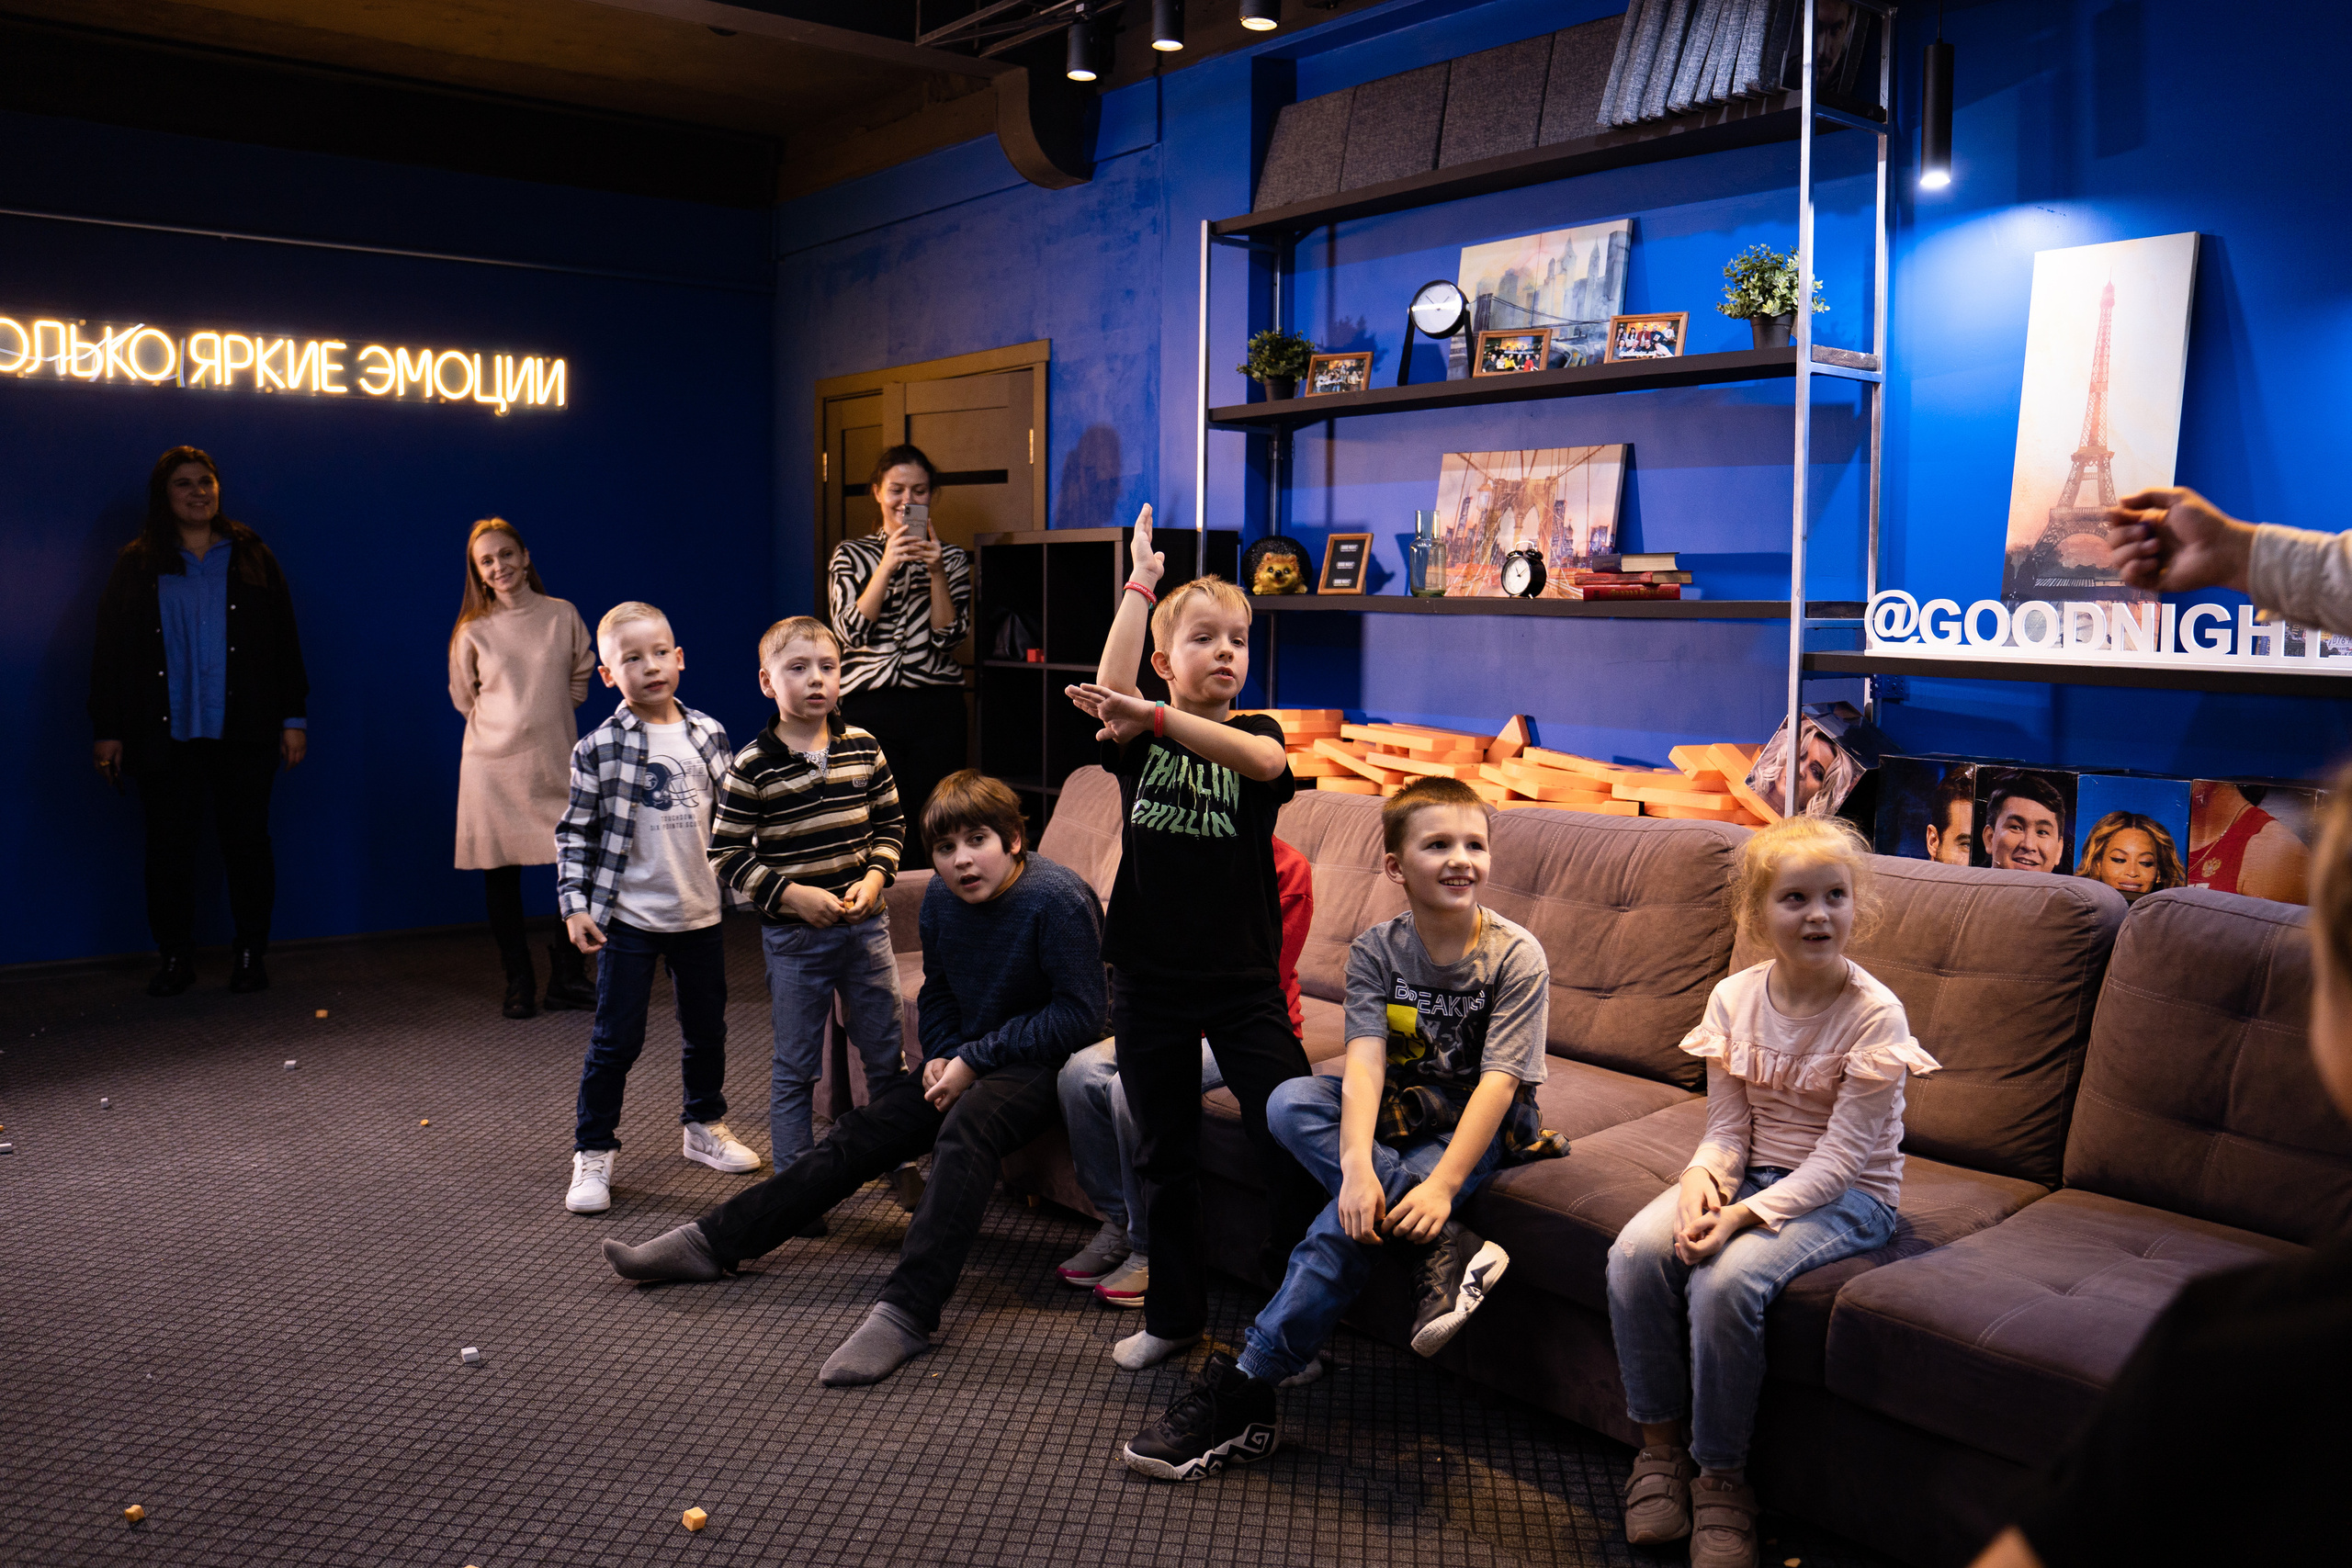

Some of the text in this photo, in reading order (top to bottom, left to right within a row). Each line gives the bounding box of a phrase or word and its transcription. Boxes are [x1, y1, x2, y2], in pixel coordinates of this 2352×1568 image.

[189, 332, 349, 393] ЯРКИЕ
[357, 344, 568, 413] ЭМОЦИИ
[1132, 798, 1238, 837] CHILLIN
